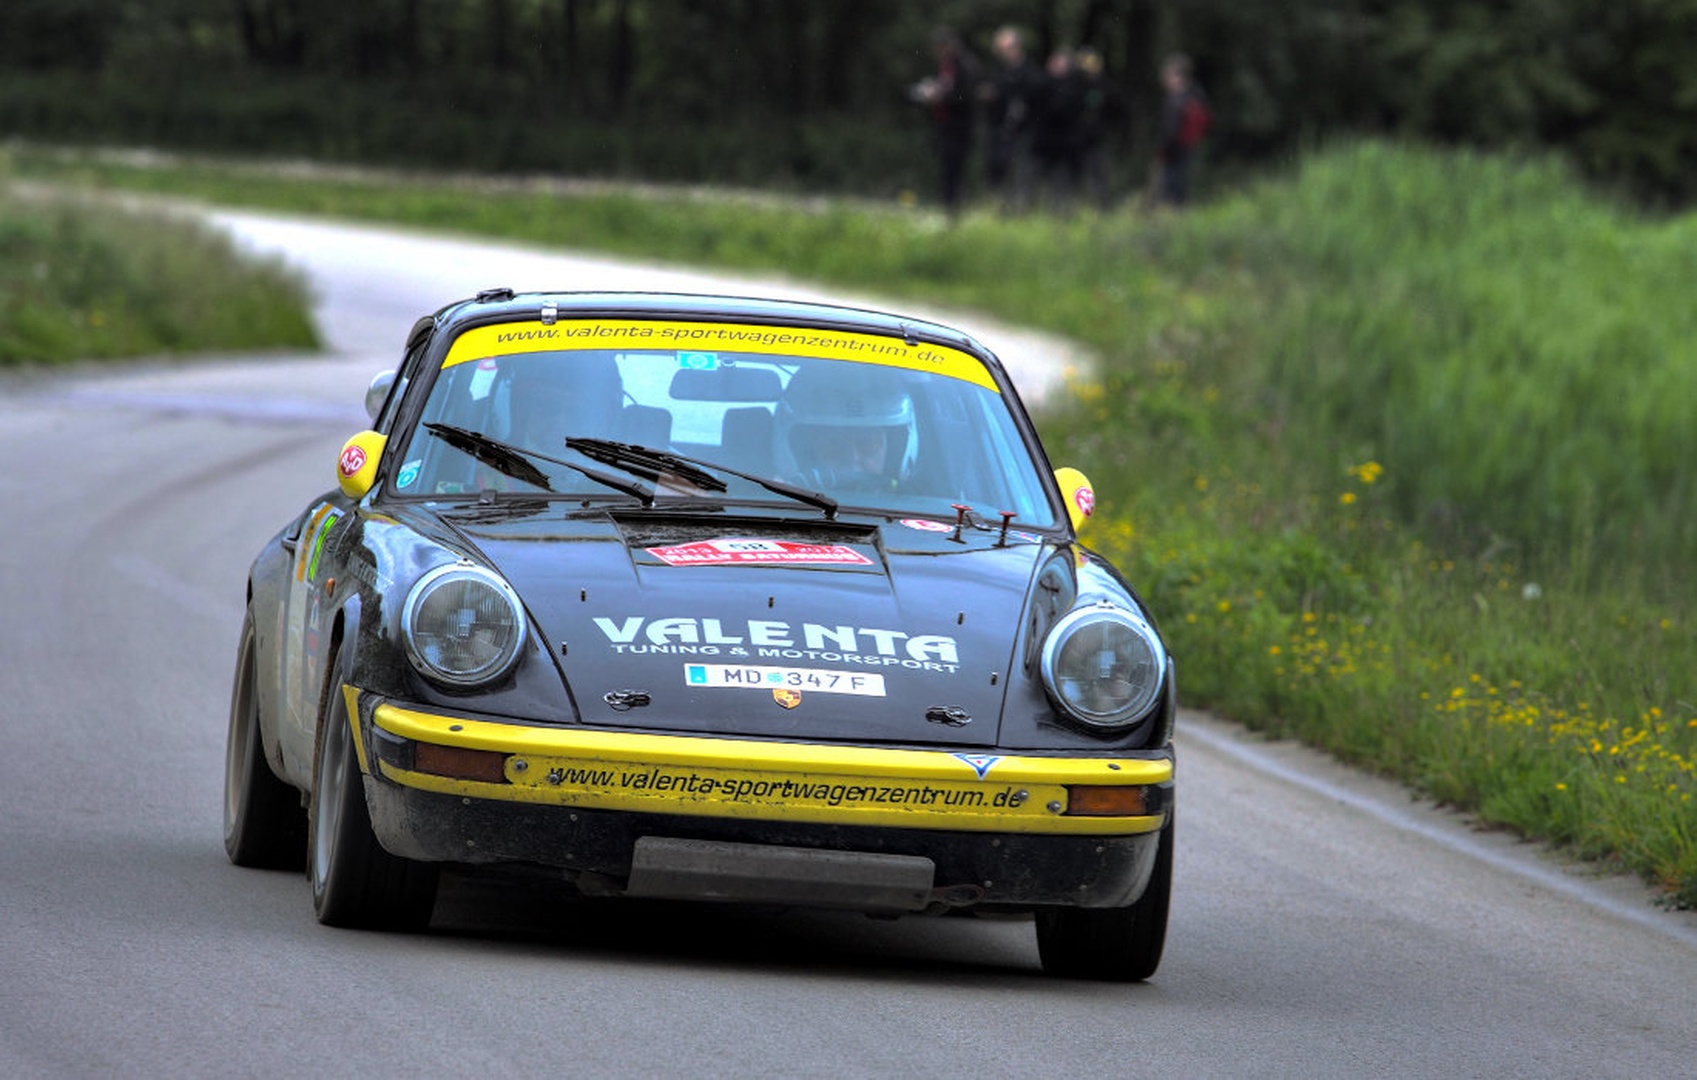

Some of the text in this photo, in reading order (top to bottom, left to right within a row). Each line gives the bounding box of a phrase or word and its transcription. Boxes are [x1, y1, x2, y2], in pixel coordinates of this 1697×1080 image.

[497, 324, 946, 365] www.valenta-sportwagenzentrum.de
[592, 616, 960, 663] VALENTA
[610, 643, 961, 674] TUNING & MOTORSPORT
[724, 668, 762, 685] MD
[787, 672, 841, 689] 347
[549, 766, 1023, 809] www.valenta-sportwagenzentrum.de
